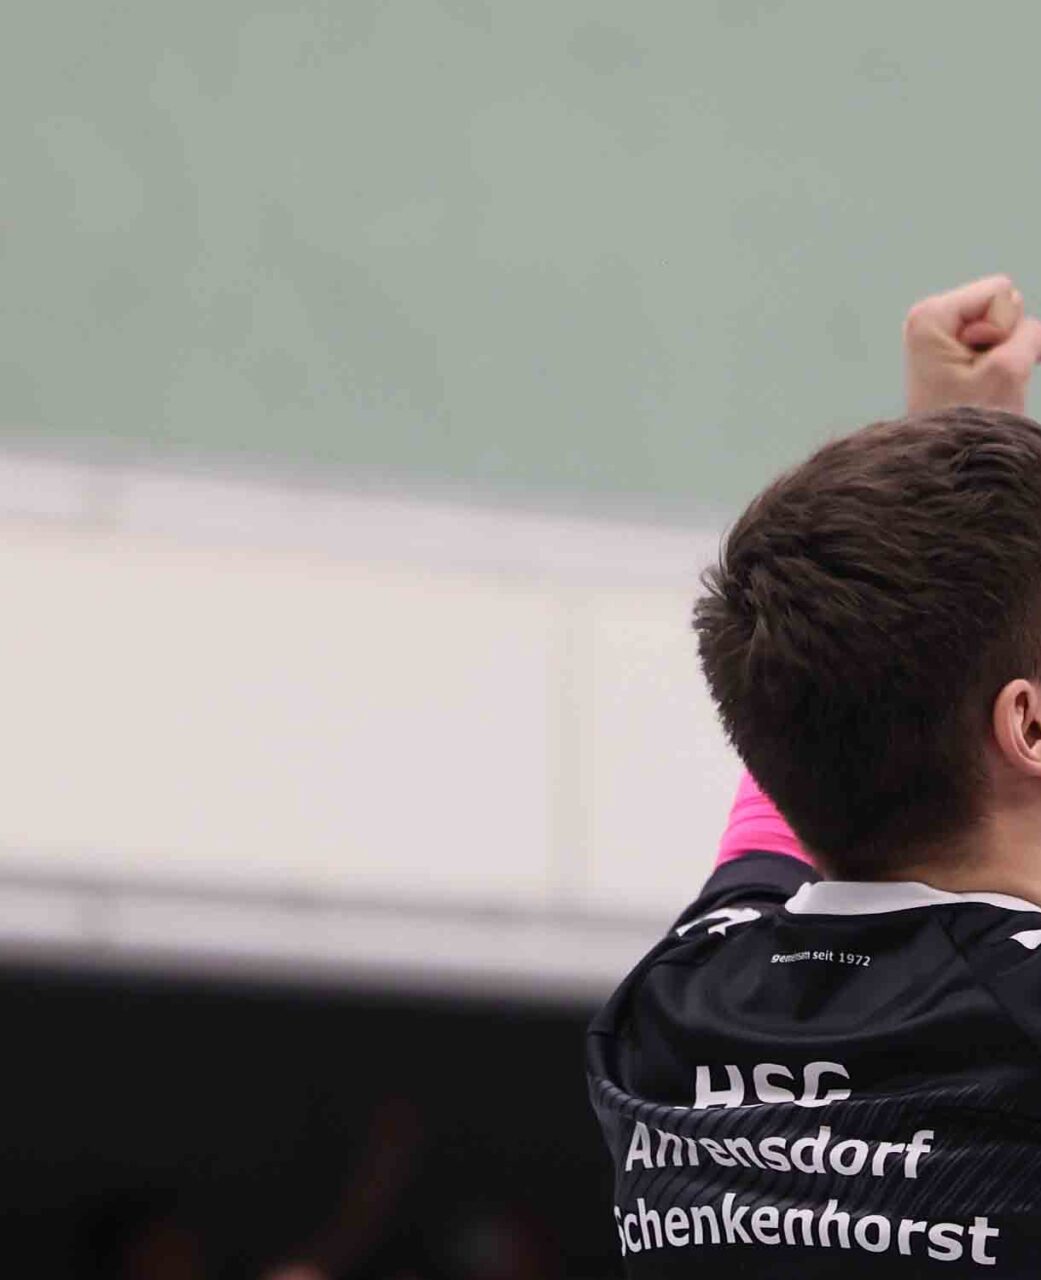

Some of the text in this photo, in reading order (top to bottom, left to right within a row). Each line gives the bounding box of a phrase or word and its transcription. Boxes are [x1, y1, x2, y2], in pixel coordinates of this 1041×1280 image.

[812, 949, 834, 962] seit
[839, 952, 871, 967] 1972
[693, 1061, 852, 1110] HSG
